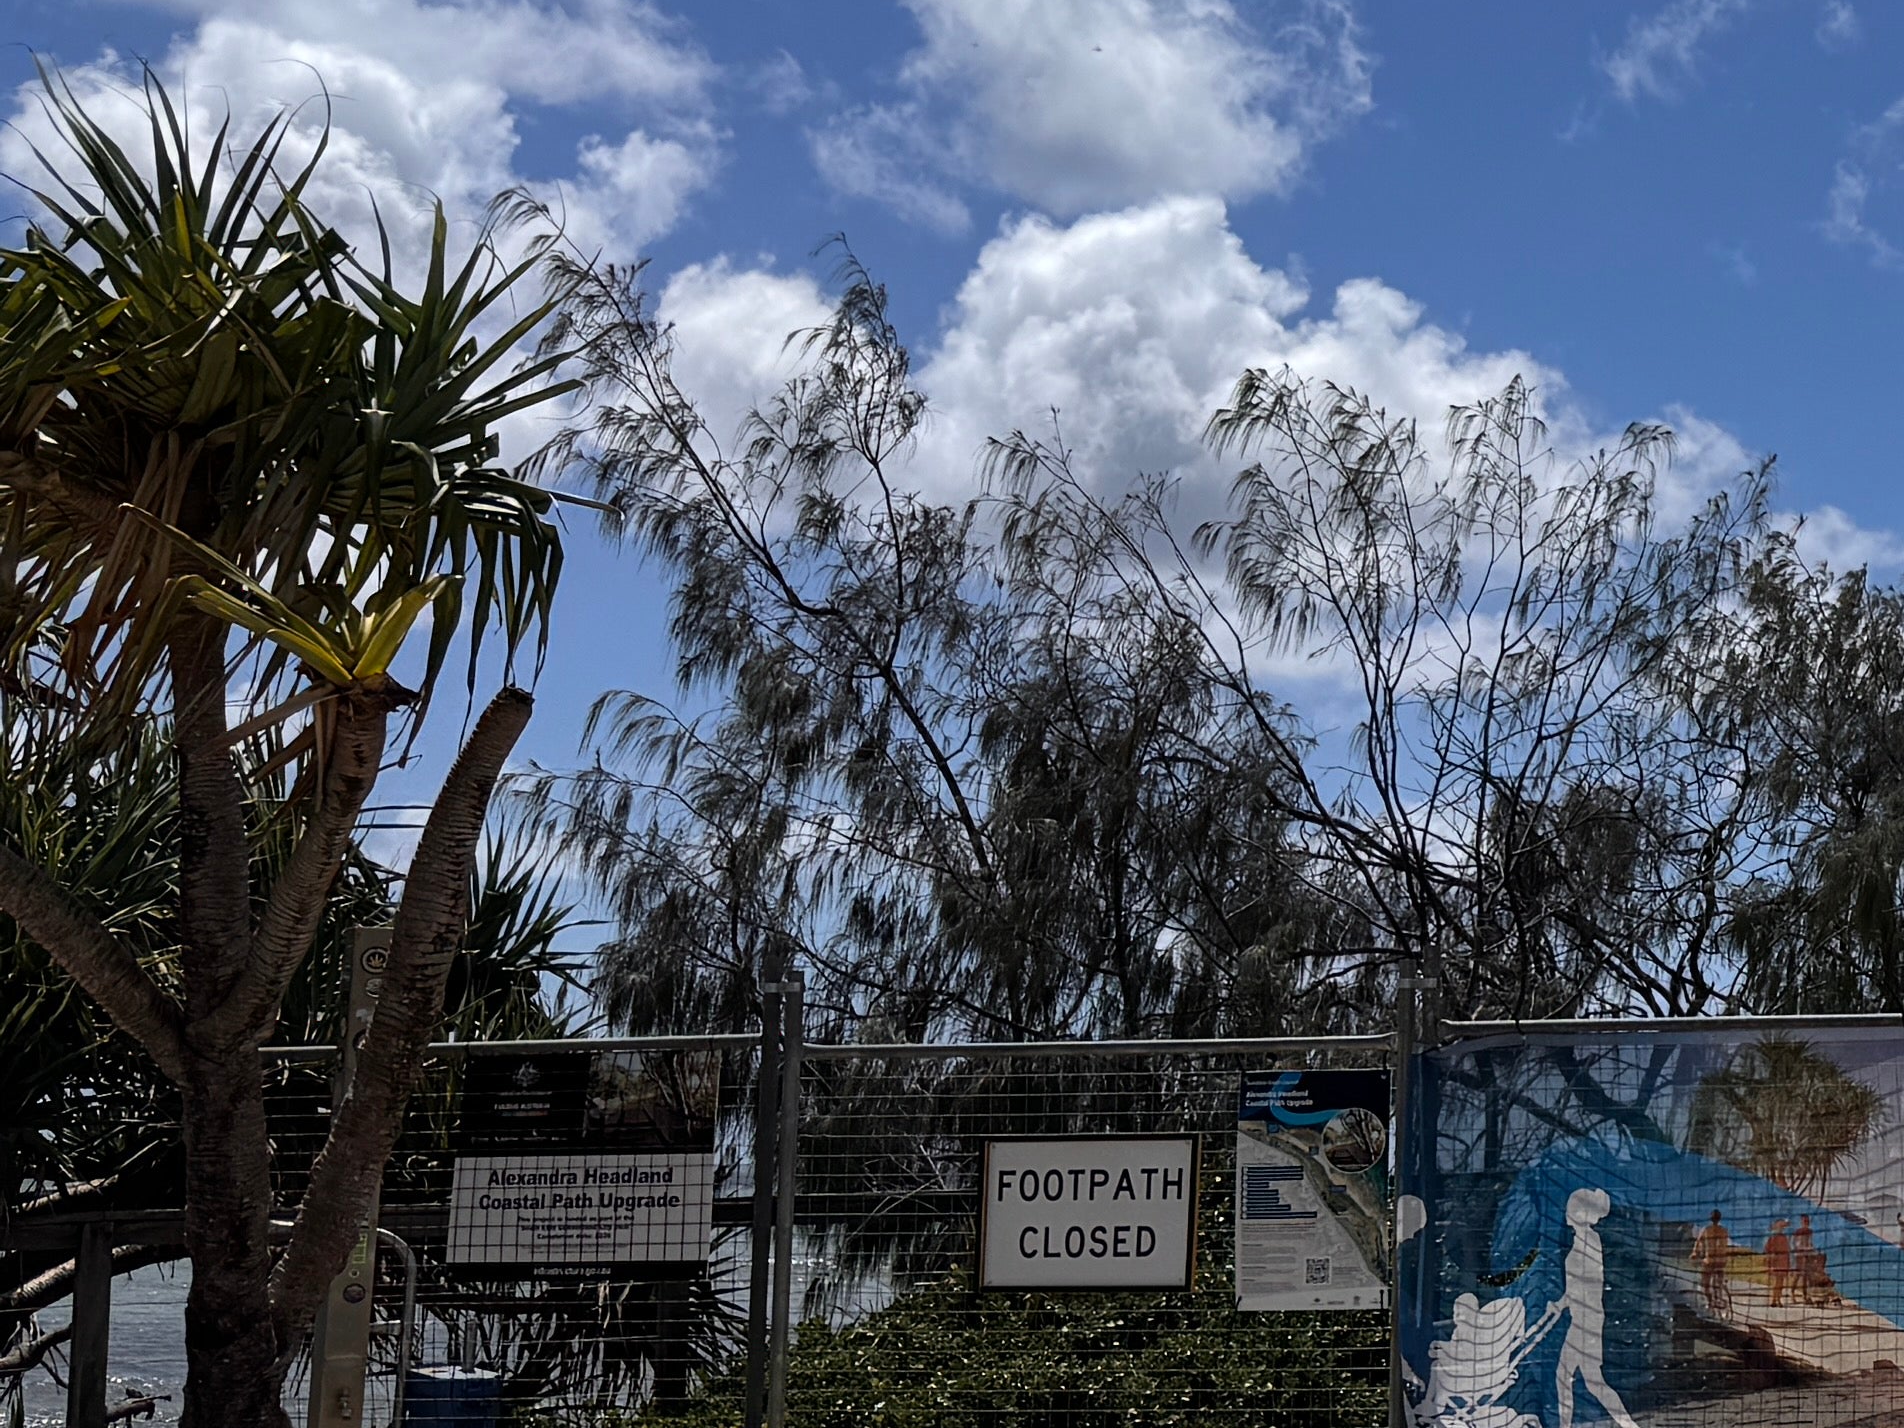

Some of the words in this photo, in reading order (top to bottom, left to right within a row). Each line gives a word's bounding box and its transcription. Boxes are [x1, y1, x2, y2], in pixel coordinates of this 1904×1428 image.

[488, 1169, 577, 1186] Alexandra
[583, 1167, 673, 1184] Headland
[997, 1167, 1184, 1202] FOOTPATH
[479, 1193, 545, 1211] Coastal
[551, 1192, 593, 1209] Path
[599, 1191, 680, 1213] Upgrade
[1019, 1225, 1156, 1259] CLOSED
